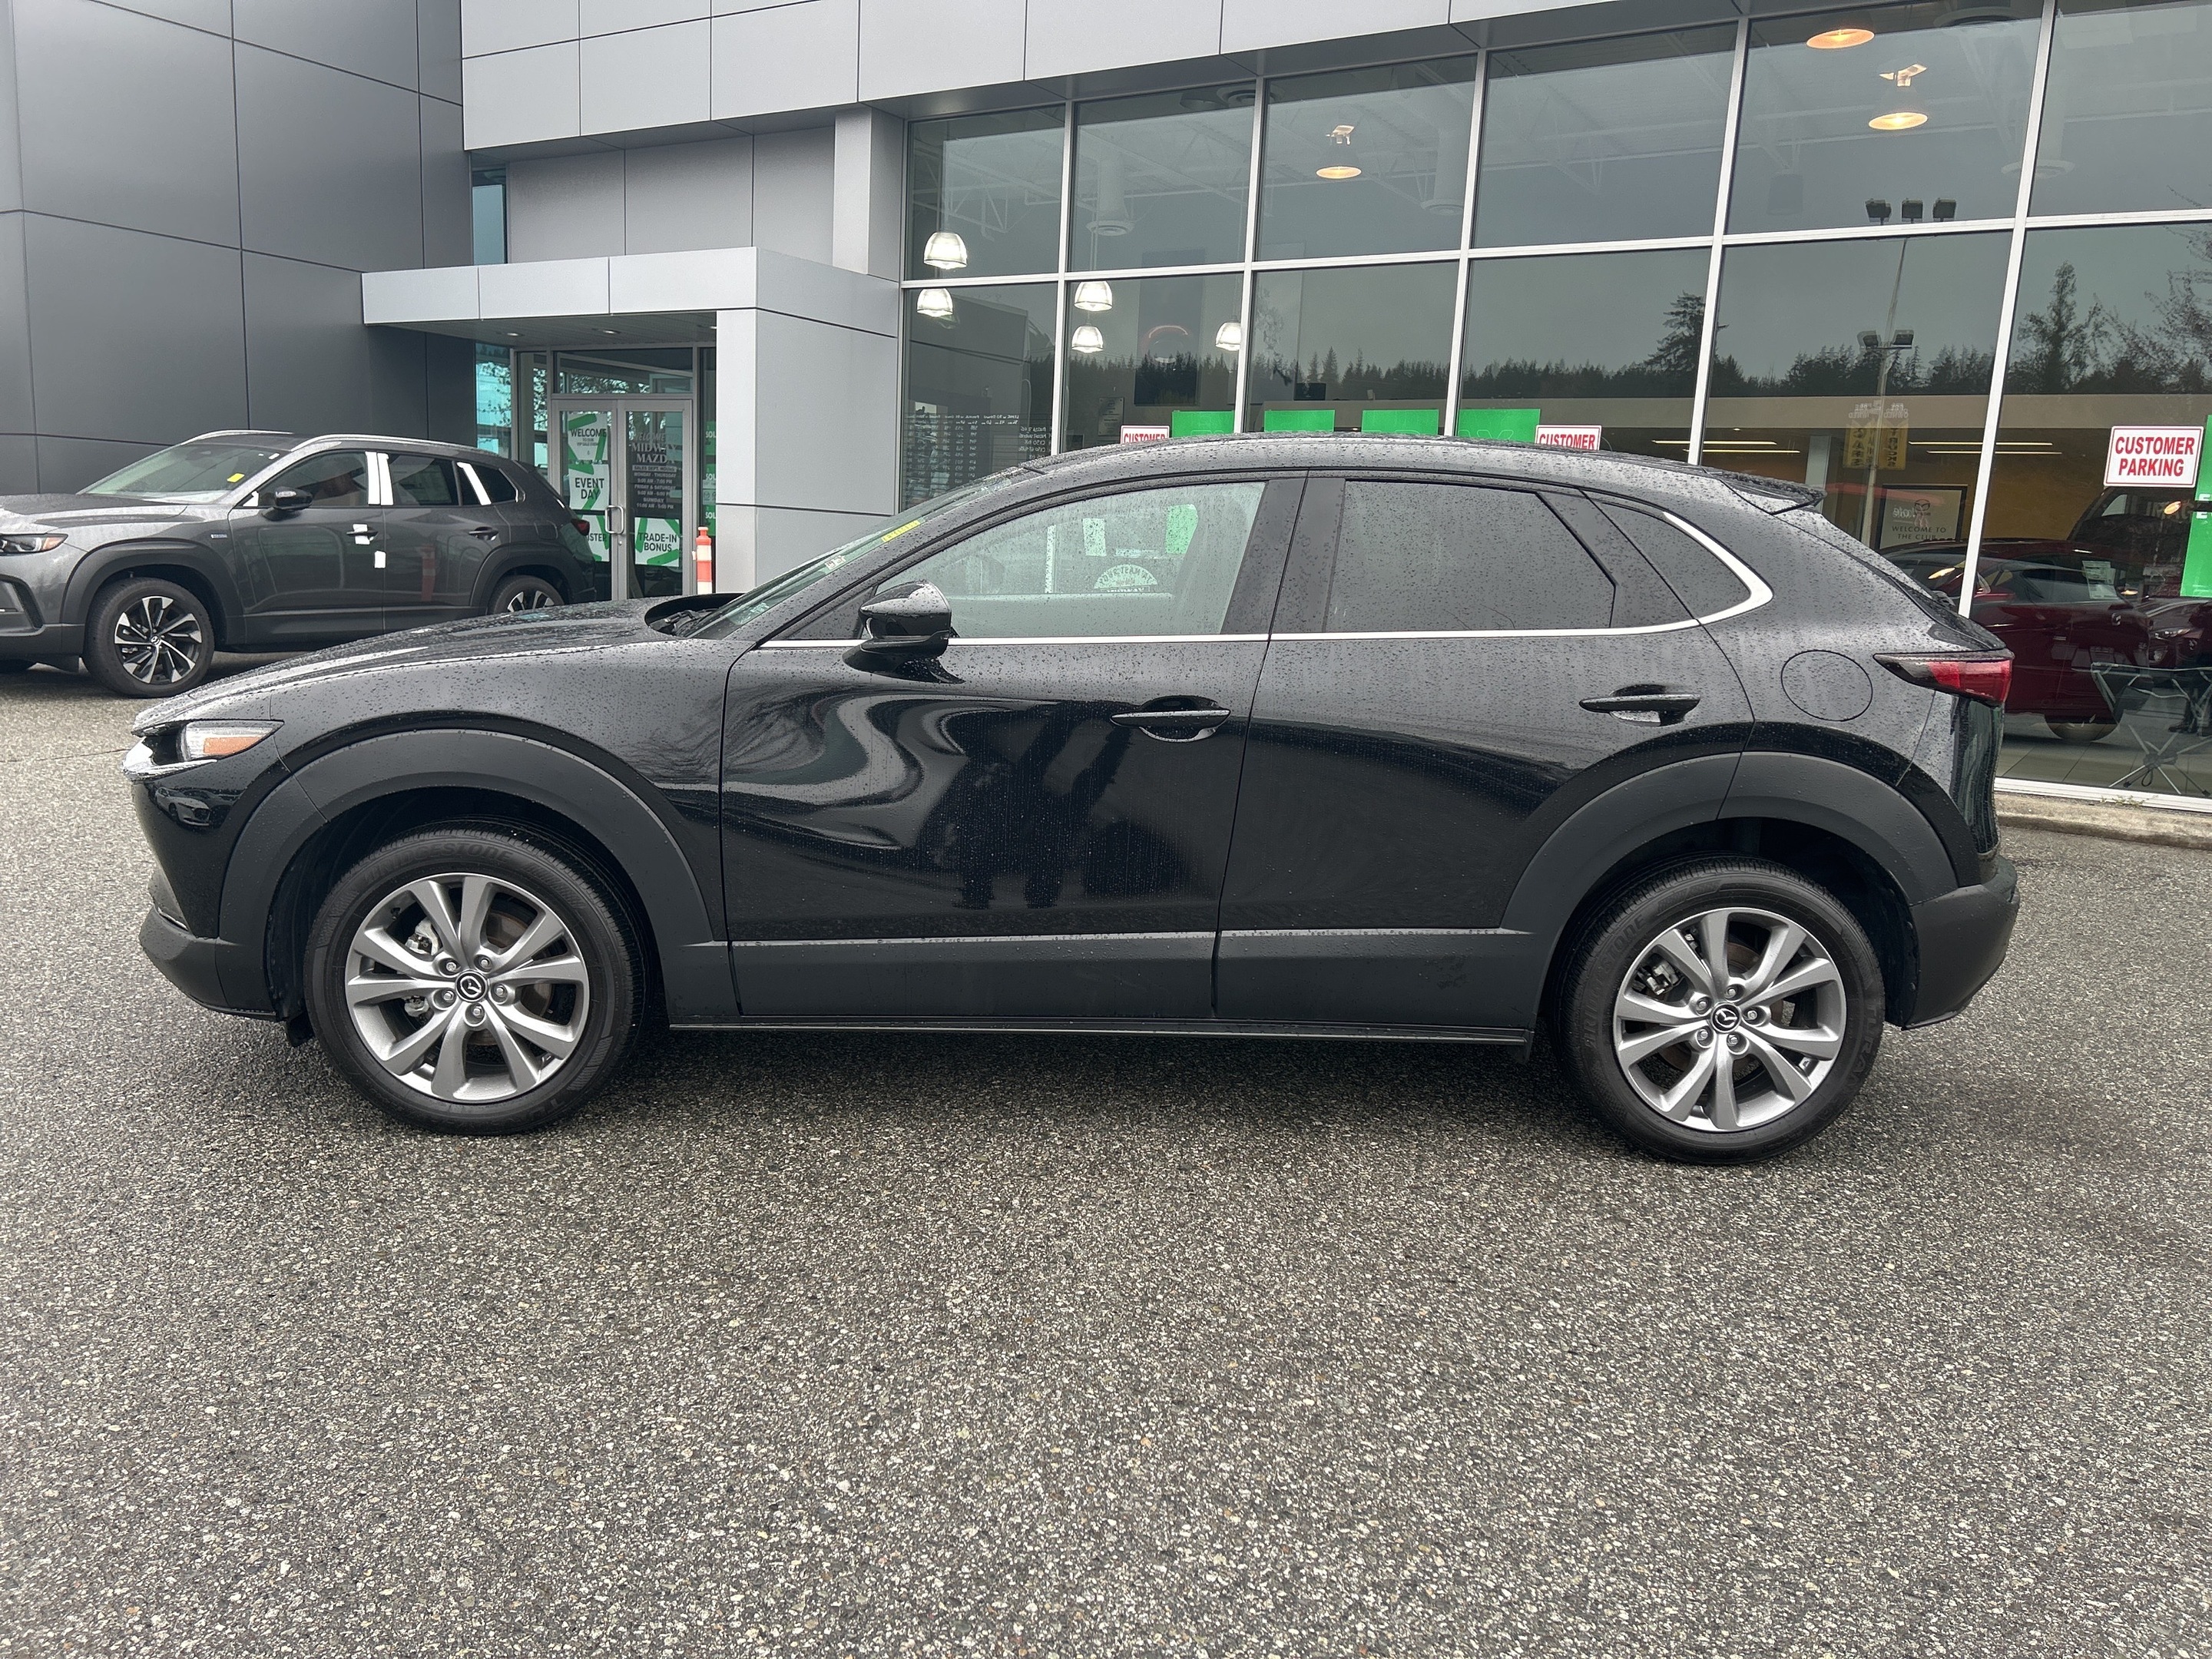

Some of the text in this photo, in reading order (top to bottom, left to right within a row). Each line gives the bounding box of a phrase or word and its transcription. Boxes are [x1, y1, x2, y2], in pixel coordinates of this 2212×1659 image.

[571, 428, 607, 437] WELCOME
[1539, 434, 1595, 450] CUSTOMER
[2115, 436, 2194, 455] CUSTOMER
[2118, 459, 2184, 476] PARKING
[575, 478, 604, 488] EVENT
[581, 489, 600, 499] DAY
[638, 533, 677, 543] TRADE-IN
[644, 543, 672, 552] BONUS
